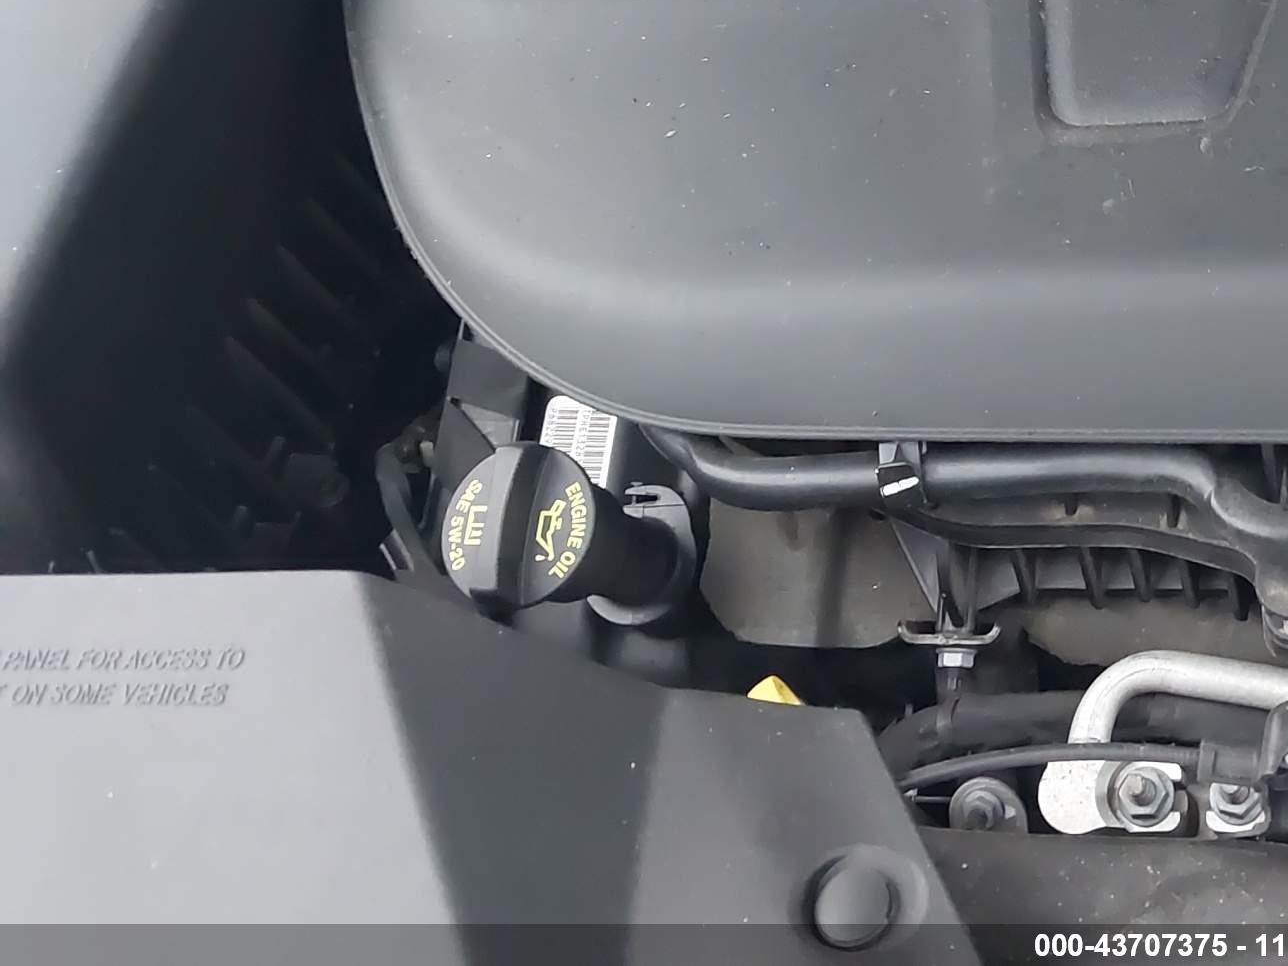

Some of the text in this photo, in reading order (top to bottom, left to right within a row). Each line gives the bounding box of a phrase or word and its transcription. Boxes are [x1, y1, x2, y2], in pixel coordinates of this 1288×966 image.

[448, 479, 483, 571] SAE 5W-20
[548, 481, 587, 579] ENGINE OIL
[2, 647, 247, 671] PANEL FOR ACCESS TO
[12, 683, 49, 706] ON
[51, 683, 117, 706] SOME
[124, 683, 230, 706] VEHICLES
